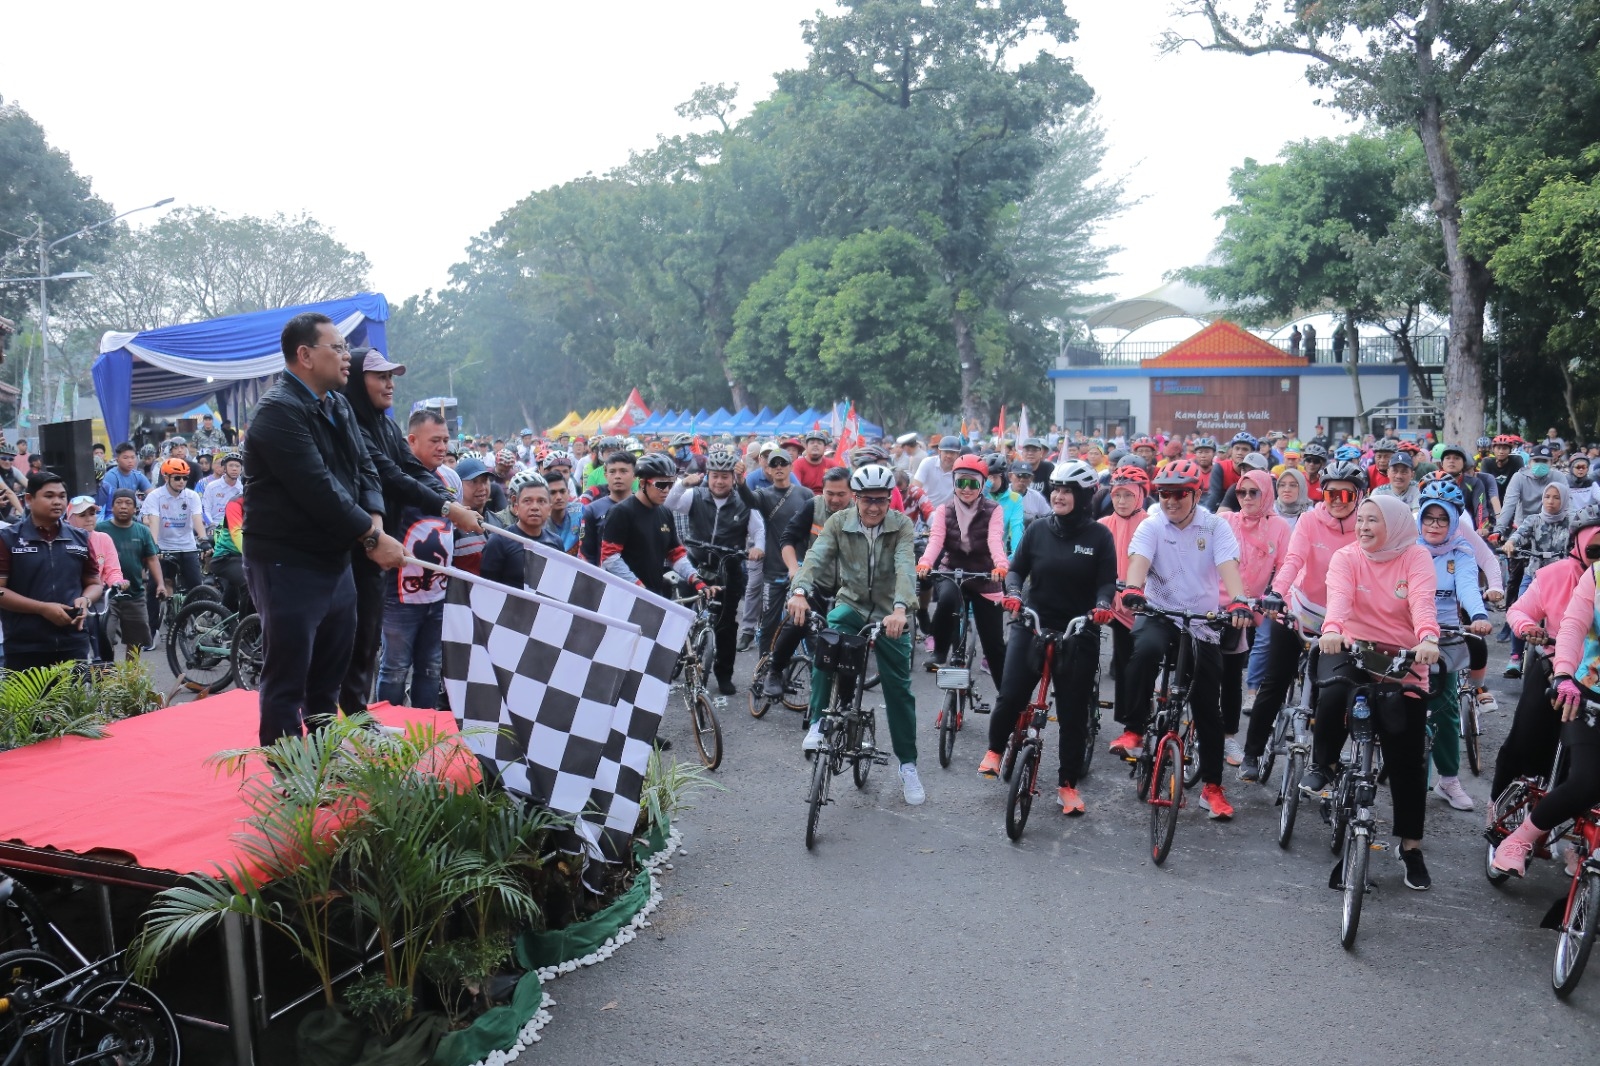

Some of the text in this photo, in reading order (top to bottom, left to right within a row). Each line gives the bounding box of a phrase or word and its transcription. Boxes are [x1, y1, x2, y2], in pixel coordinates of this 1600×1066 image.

[1174, 411, 1270, 421] Kambang Iwak Walk
[1196, 421, 1247, 430] Palembang
